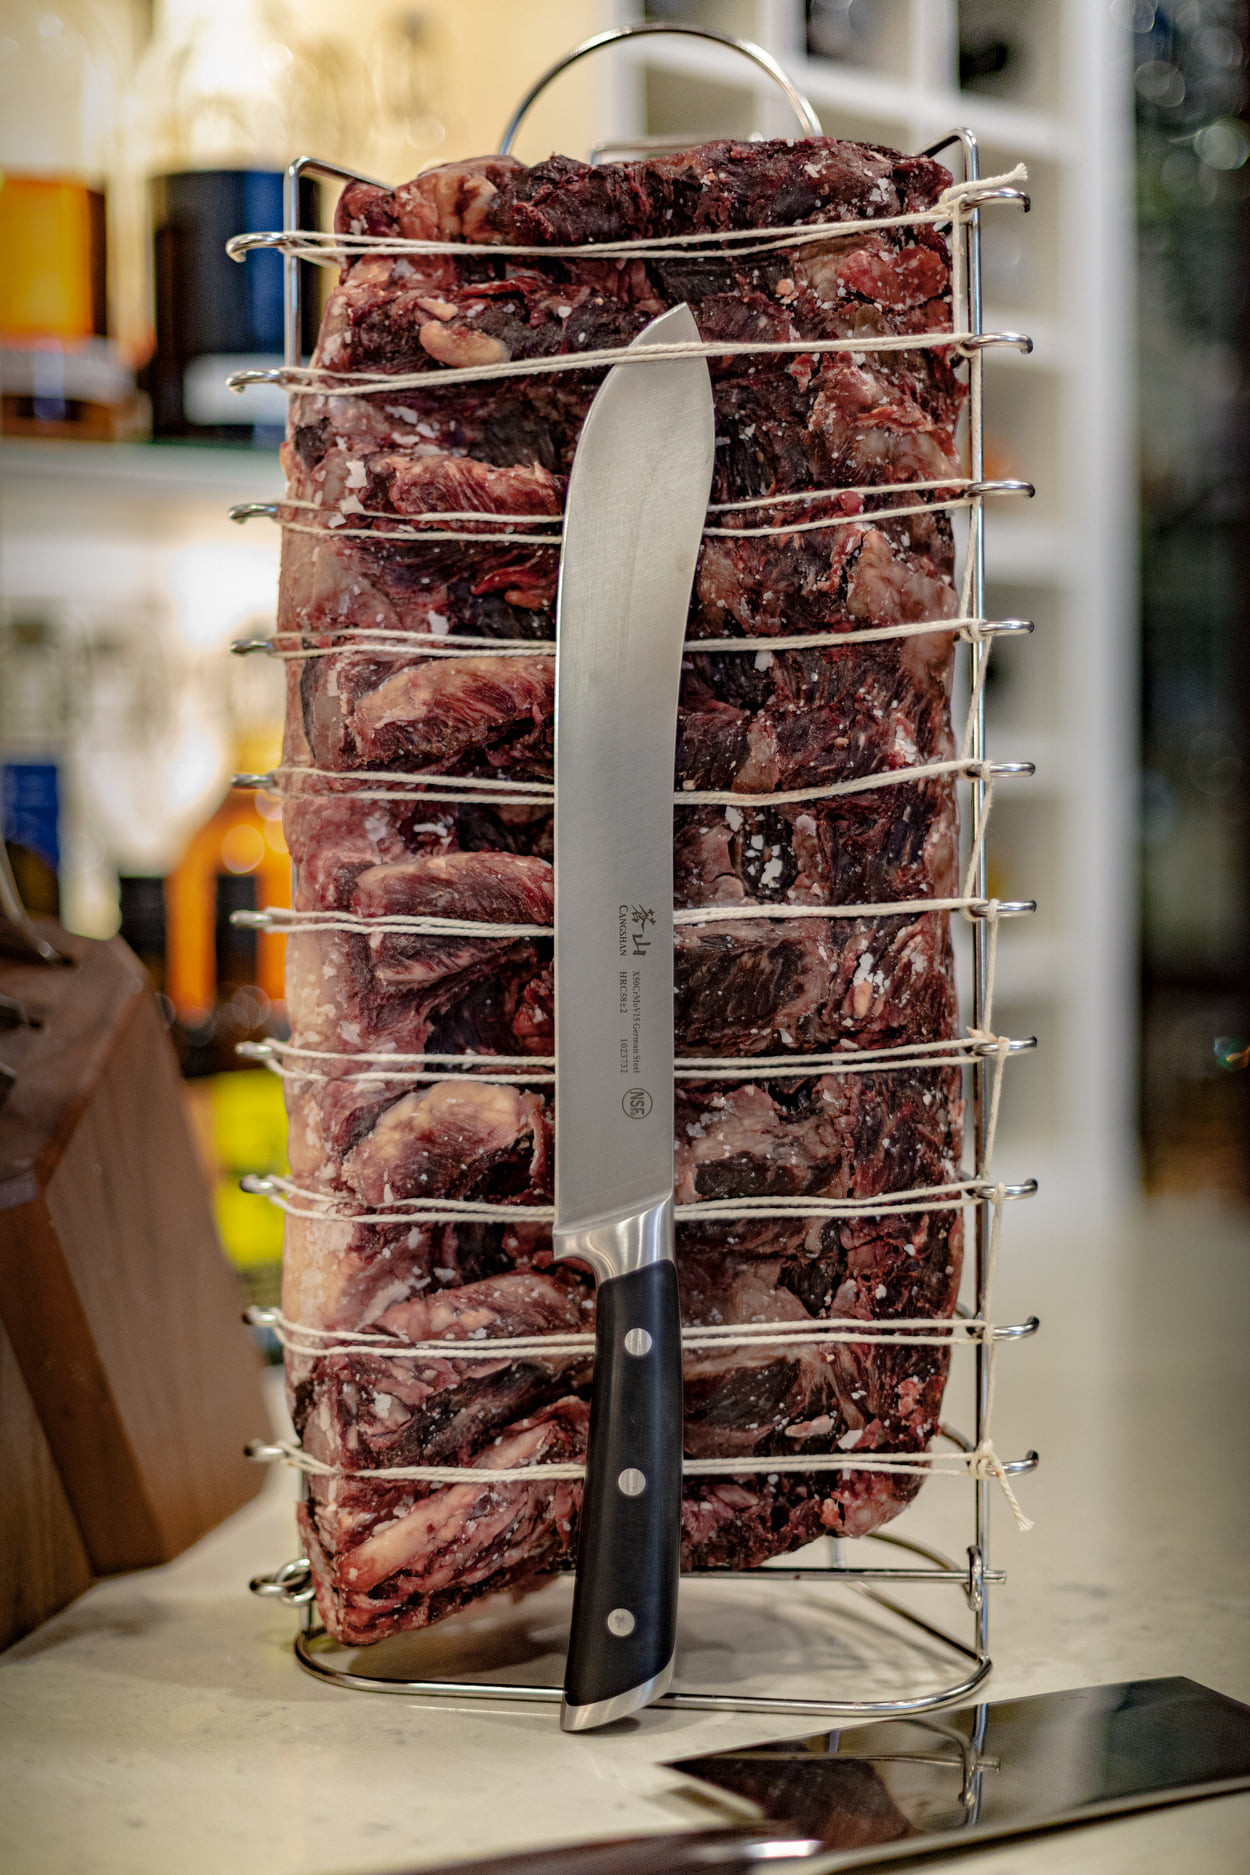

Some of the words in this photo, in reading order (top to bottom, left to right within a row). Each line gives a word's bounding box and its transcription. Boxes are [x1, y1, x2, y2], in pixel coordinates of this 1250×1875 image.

[619, 971, 628, 1013] HRC58±2
[632, 971, 641, 1021] X50CrMoV15
[632, 1022, 641, 1054] German
[619, 1039, 628, 1073] 1023732
[632, 1055, 641, 1073] Steel
